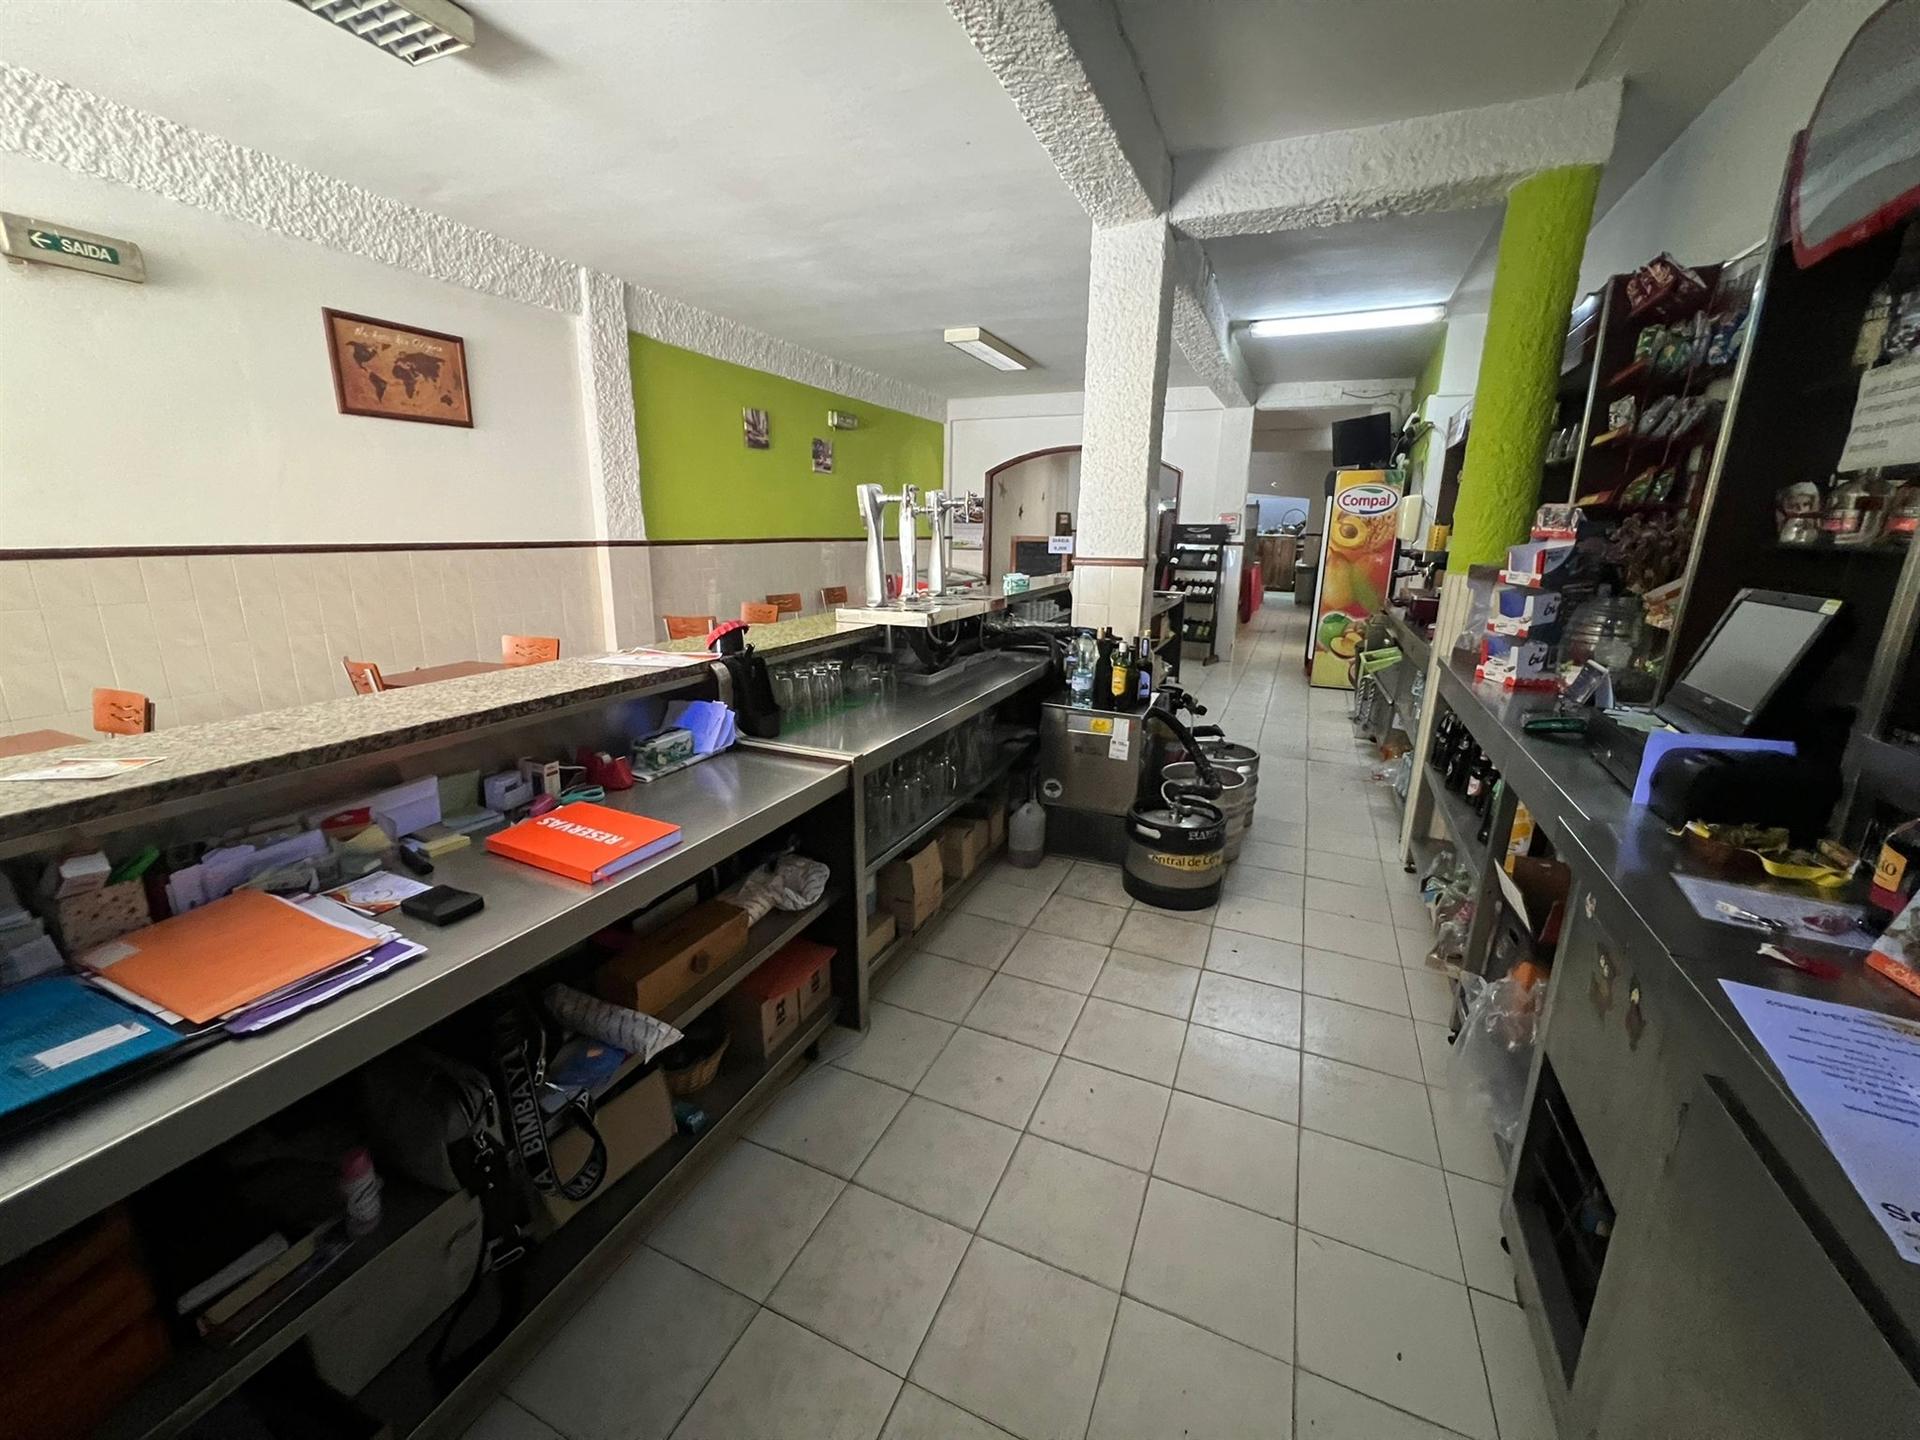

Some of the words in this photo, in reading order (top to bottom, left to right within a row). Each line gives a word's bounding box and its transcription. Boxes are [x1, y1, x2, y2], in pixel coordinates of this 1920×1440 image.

[60, 238, 112, 262] SAIDA
[1342, 494, 1391, 509] Compal
[536, 817, 624, 845] RESERVAS
[1187, 855, 1201, 867] de
[512, 1080, 544, 1158] BIMBA
